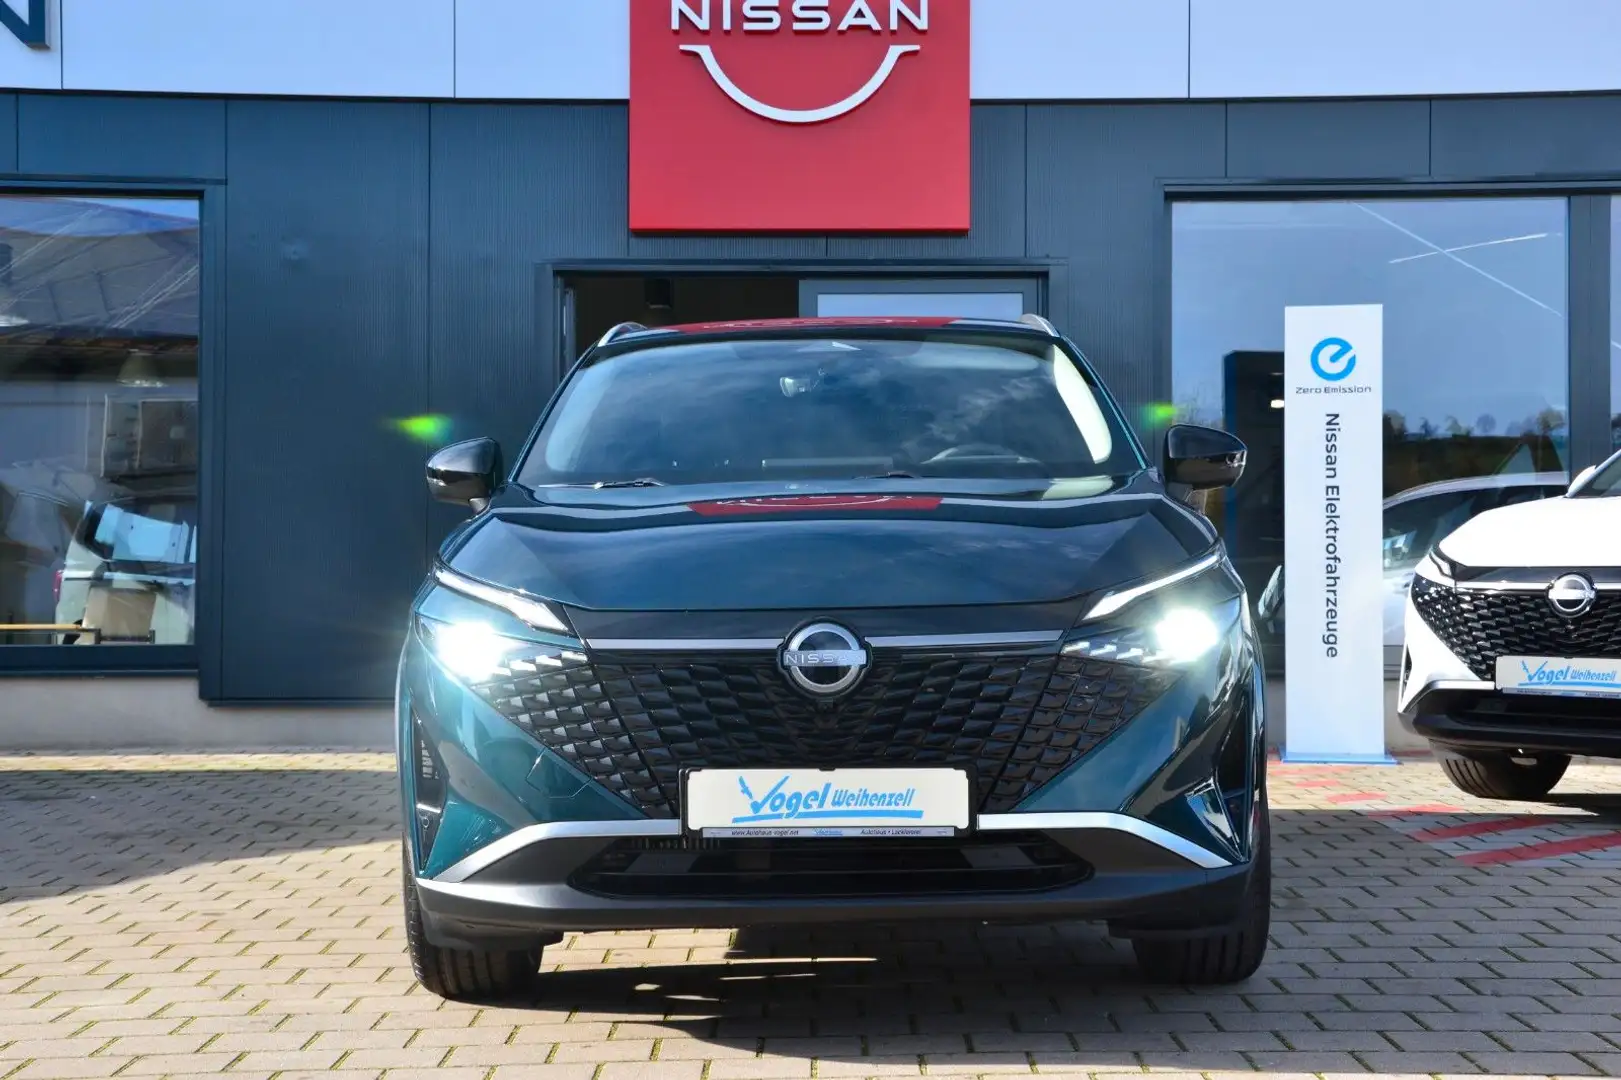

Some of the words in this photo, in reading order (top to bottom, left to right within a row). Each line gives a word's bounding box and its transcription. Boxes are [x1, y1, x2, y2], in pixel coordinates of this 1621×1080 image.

[670, 0, 929, 32] NISSAN
[1295, 386, 1321, 395] Zero
[1323, 385, 1372, 394] Emission
[1324, 413, 1341, 479] Nissan
[1322, 485, 1341, 658] Elektrofahrzeuge
[1521, 660, 1570, 684] Vogel
[1570, 668, 1617, 682] Weihenzell
[739, 776, 832, 819] Vogel
[831, 788, 916, 807] Weihenzell
